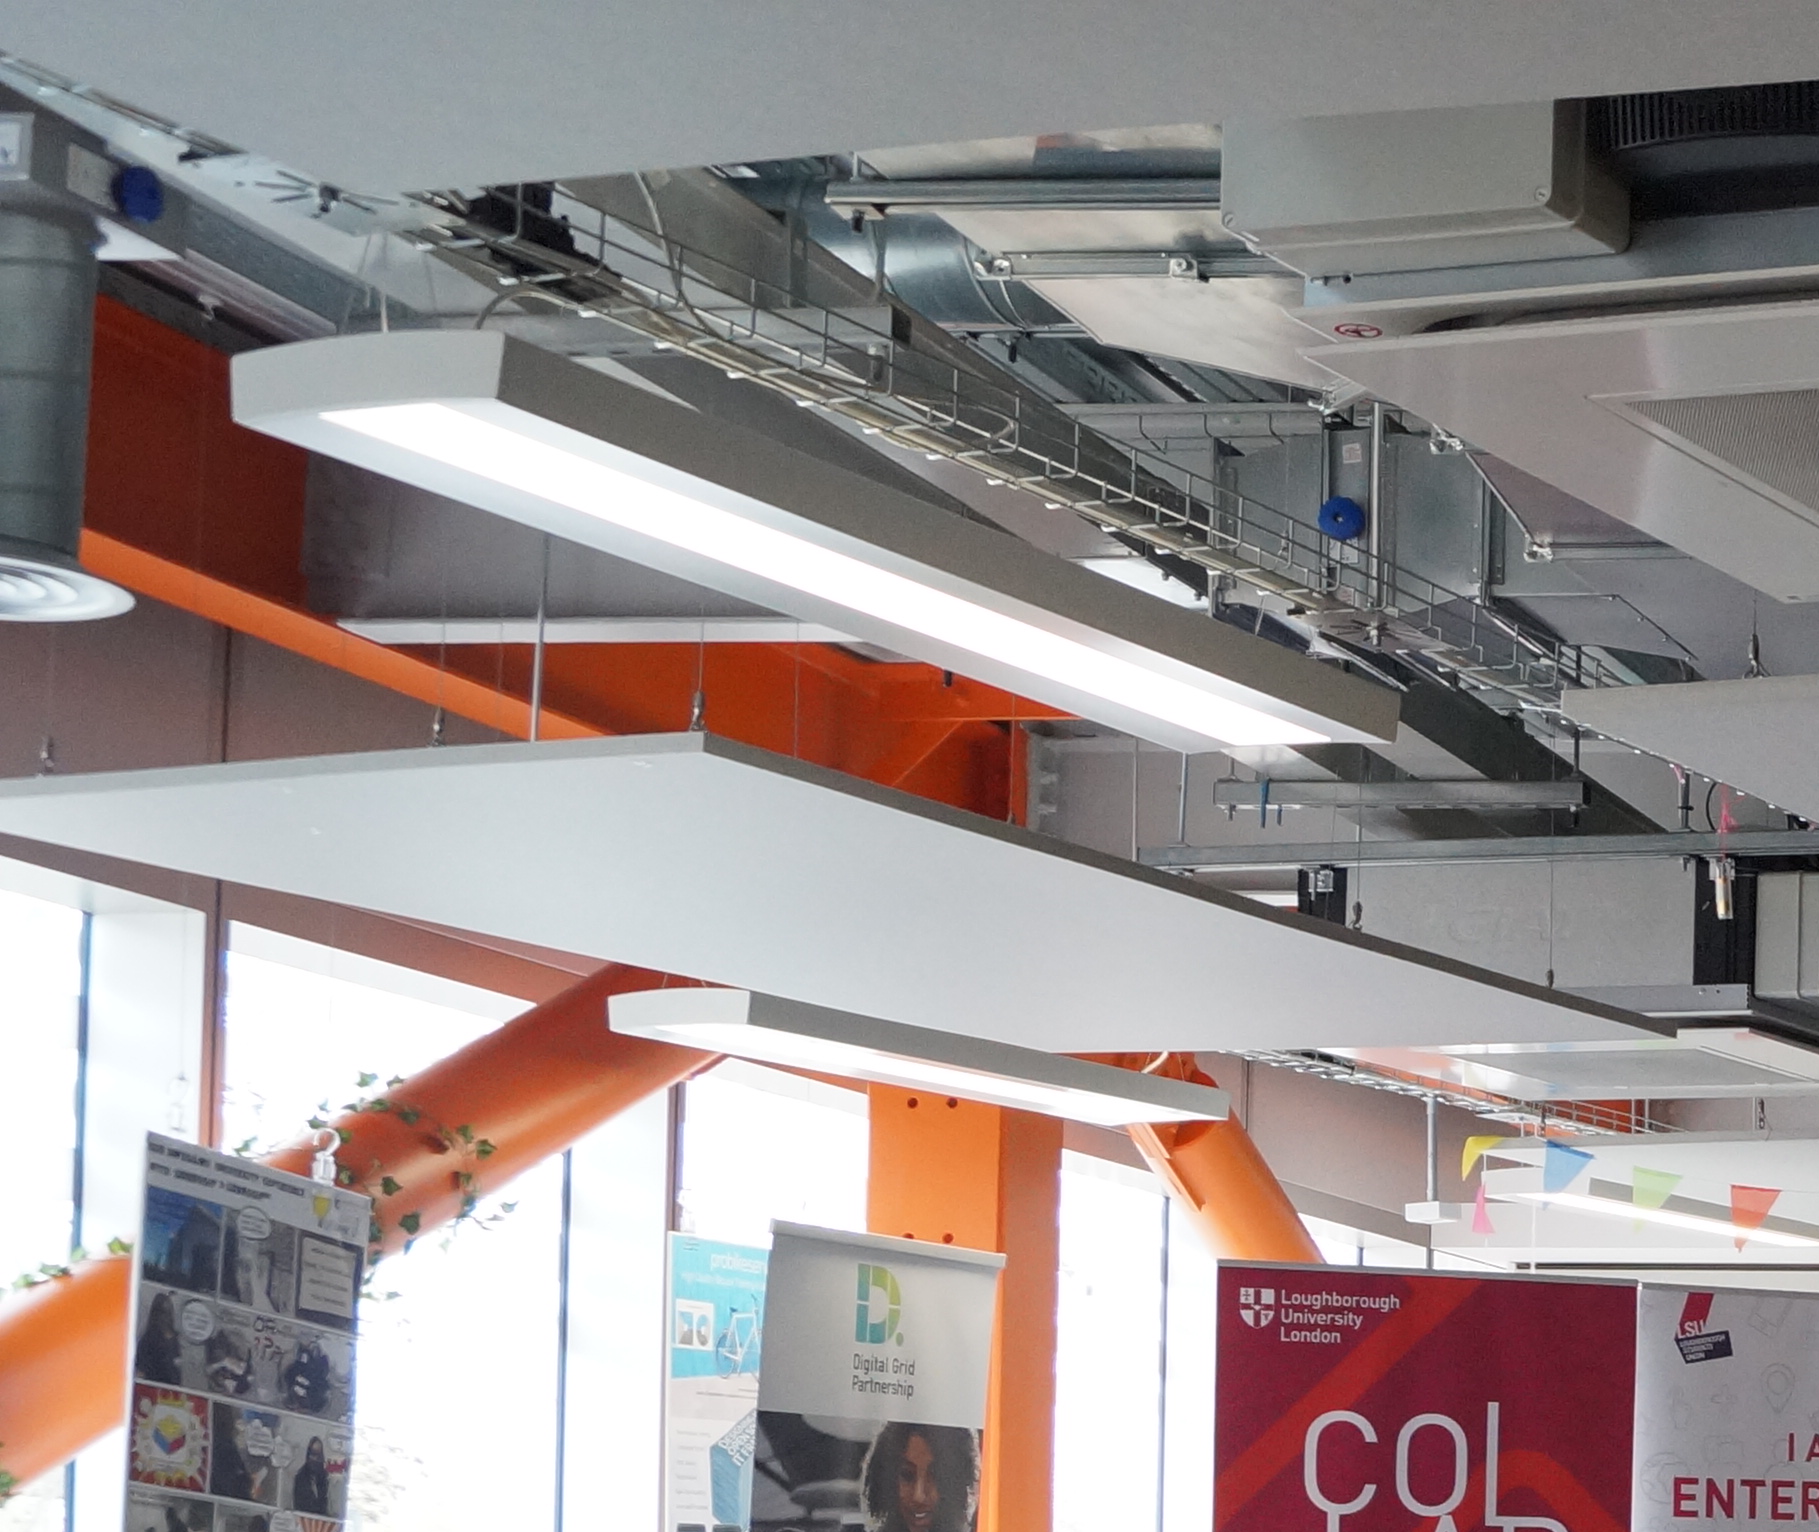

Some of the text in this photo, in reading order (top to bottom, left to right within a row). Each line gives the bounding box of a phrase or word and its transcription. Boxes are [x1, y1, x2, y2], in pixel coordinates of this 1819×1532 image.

[1281, 1289, 1400, 1312] Loughborough
[1281, 1308, 1363, 1330] University
[1677, 1319, 1704, 1339] LSU
[1280, 1326, 1341, 1343] London
[853, 1353, 915, 1376] Digital Grid
[852, 1375, 914, 1401] Partnership
[1788, 1432, 1795, 1462] I
